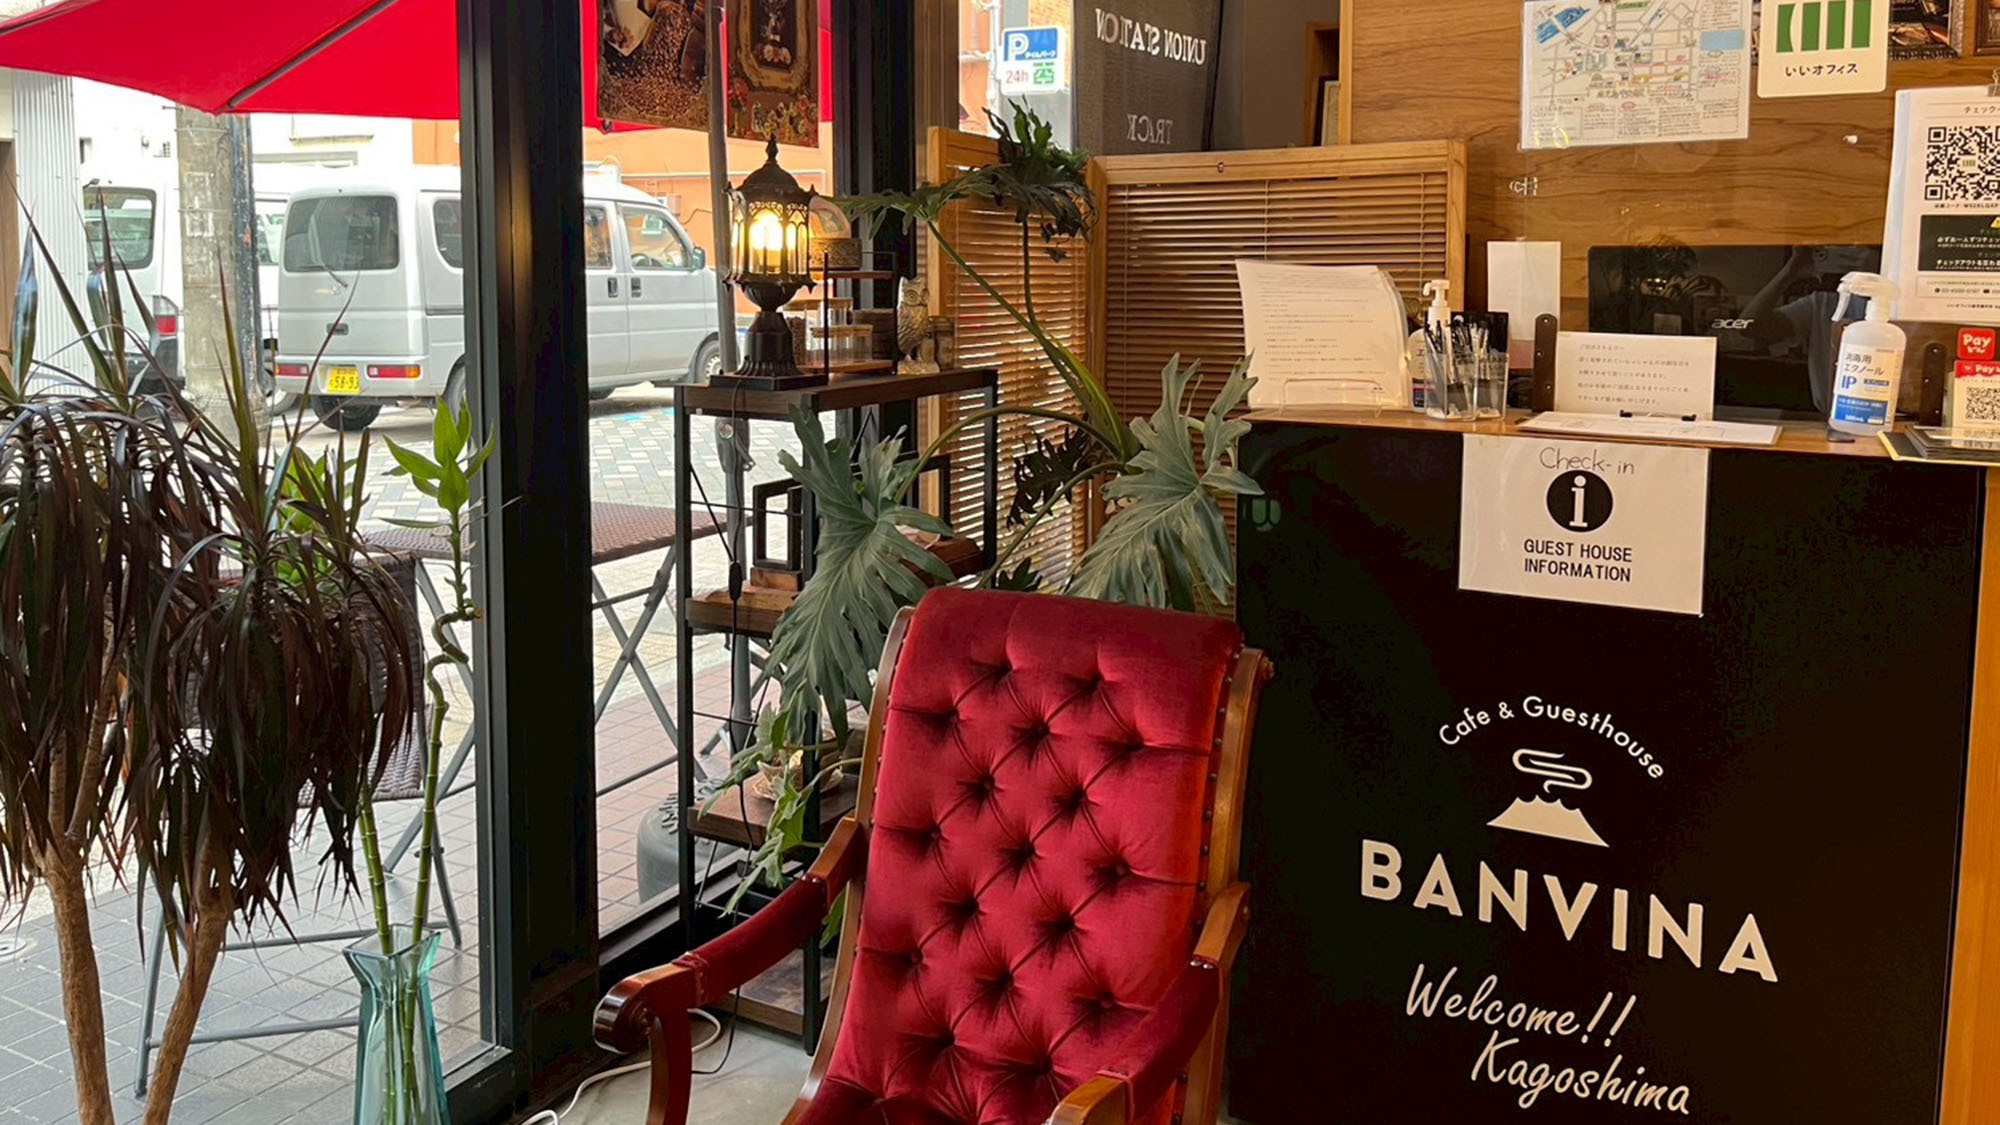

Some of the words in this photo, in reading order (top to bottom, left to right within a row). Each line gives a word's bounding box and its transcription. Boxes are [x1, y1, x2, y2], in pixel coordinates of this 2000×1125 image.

[1007, 32, 1029, 61] P
[1006, 69, 1029, 84] 24h
[1785, 62, 1858, 77] いいオフィス
[1711, 318, 1754, 329] acer
[1962, 333, 1992, 348] Pay
[1841, 375, 1857, 389] IP
[1844, 363, 1885, 376] エタノール
[1523, 538, 1574, 557] GUEST
[1580, 543, 1633, 563] HOUSE
[1524, 558, 1632, 583] INFORMATION
[1438, 707, 1491, 745] Cafe
[1498, 702, 1514, 719] &
[1522, 695, 1664, 779] Guesthouse
[1360, 838, 1778, 983] BANVINA
[1405, 963, 1637, 1047] Welcome!!
[1470, 1030, 1690, 1115] Kagoshima
